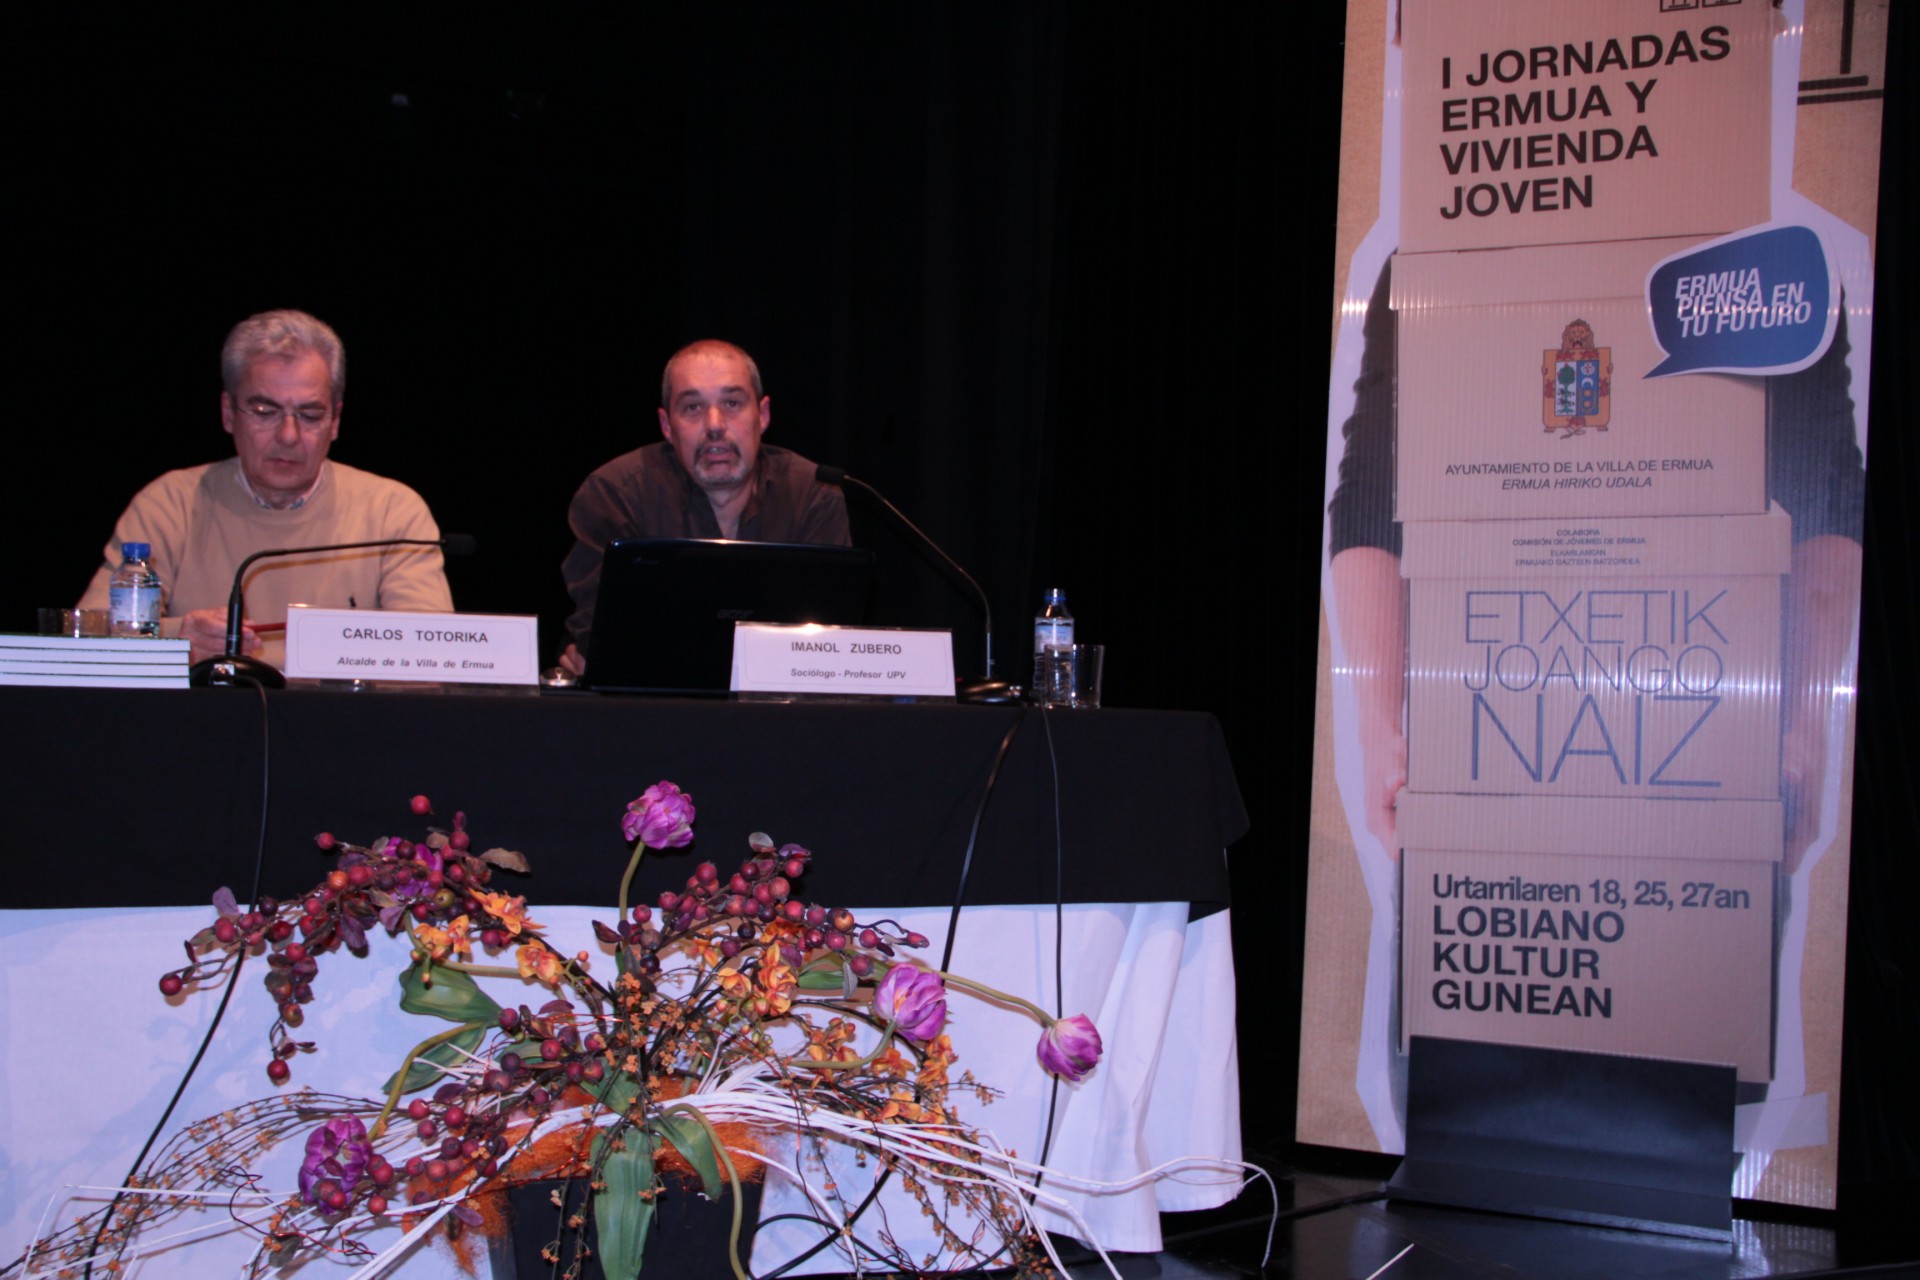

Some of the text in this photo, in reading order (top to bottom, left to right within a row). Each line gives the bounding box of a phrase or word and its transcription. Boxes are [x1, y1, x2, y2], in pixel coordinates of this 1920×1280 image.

[1441, 25, 1731, 88] I JORNADAS
[1442, 79, 1657, 132] ERMUA Y
[1439, 125, 1658, 175] VIVIENDA
[1439, 175, 1594, 220] JOVEN
[1675, 267, 1761, 299] ERMUA
[1676, 282, 1805, 319] PIENSA EN
[1680, 301, 1811, 338] TU FUTURO
[1445, 459, 1713, 475] AYUNTAMIENTO DE LA VILLA DE ERMUA
[1501, 476, 1652, 490] ERMUA HIRIKO UDALA
[1617, 537, 1646, 545] ERMUA
[1465, 589, 1729, 644] ETXETIK
[342, 628, 488, 643] CARLOS TOTORIKA
[791, 641, 902, 654] IMANOL ZUBERO
[337, 657, 494, 669] Alcalde de la Villa de Ermua
[790, 668, 836, 679] Sociólogo
[844, 670, 882, 679] Profesor
[887, 671, 906, 679] UPV
[1463, 644, 1723, 693] JOANGO
[1471, 693, 1722, 787] NAIZ
[1432, 873, 1750, 911] Urtarrilaren 18, 25, 27an
[1433, 905, 1625, 942] LOBIANO
[1433, 942, 1600, 979] KULTUR
[1432, 979, 1613, 1018] GUNEAN
